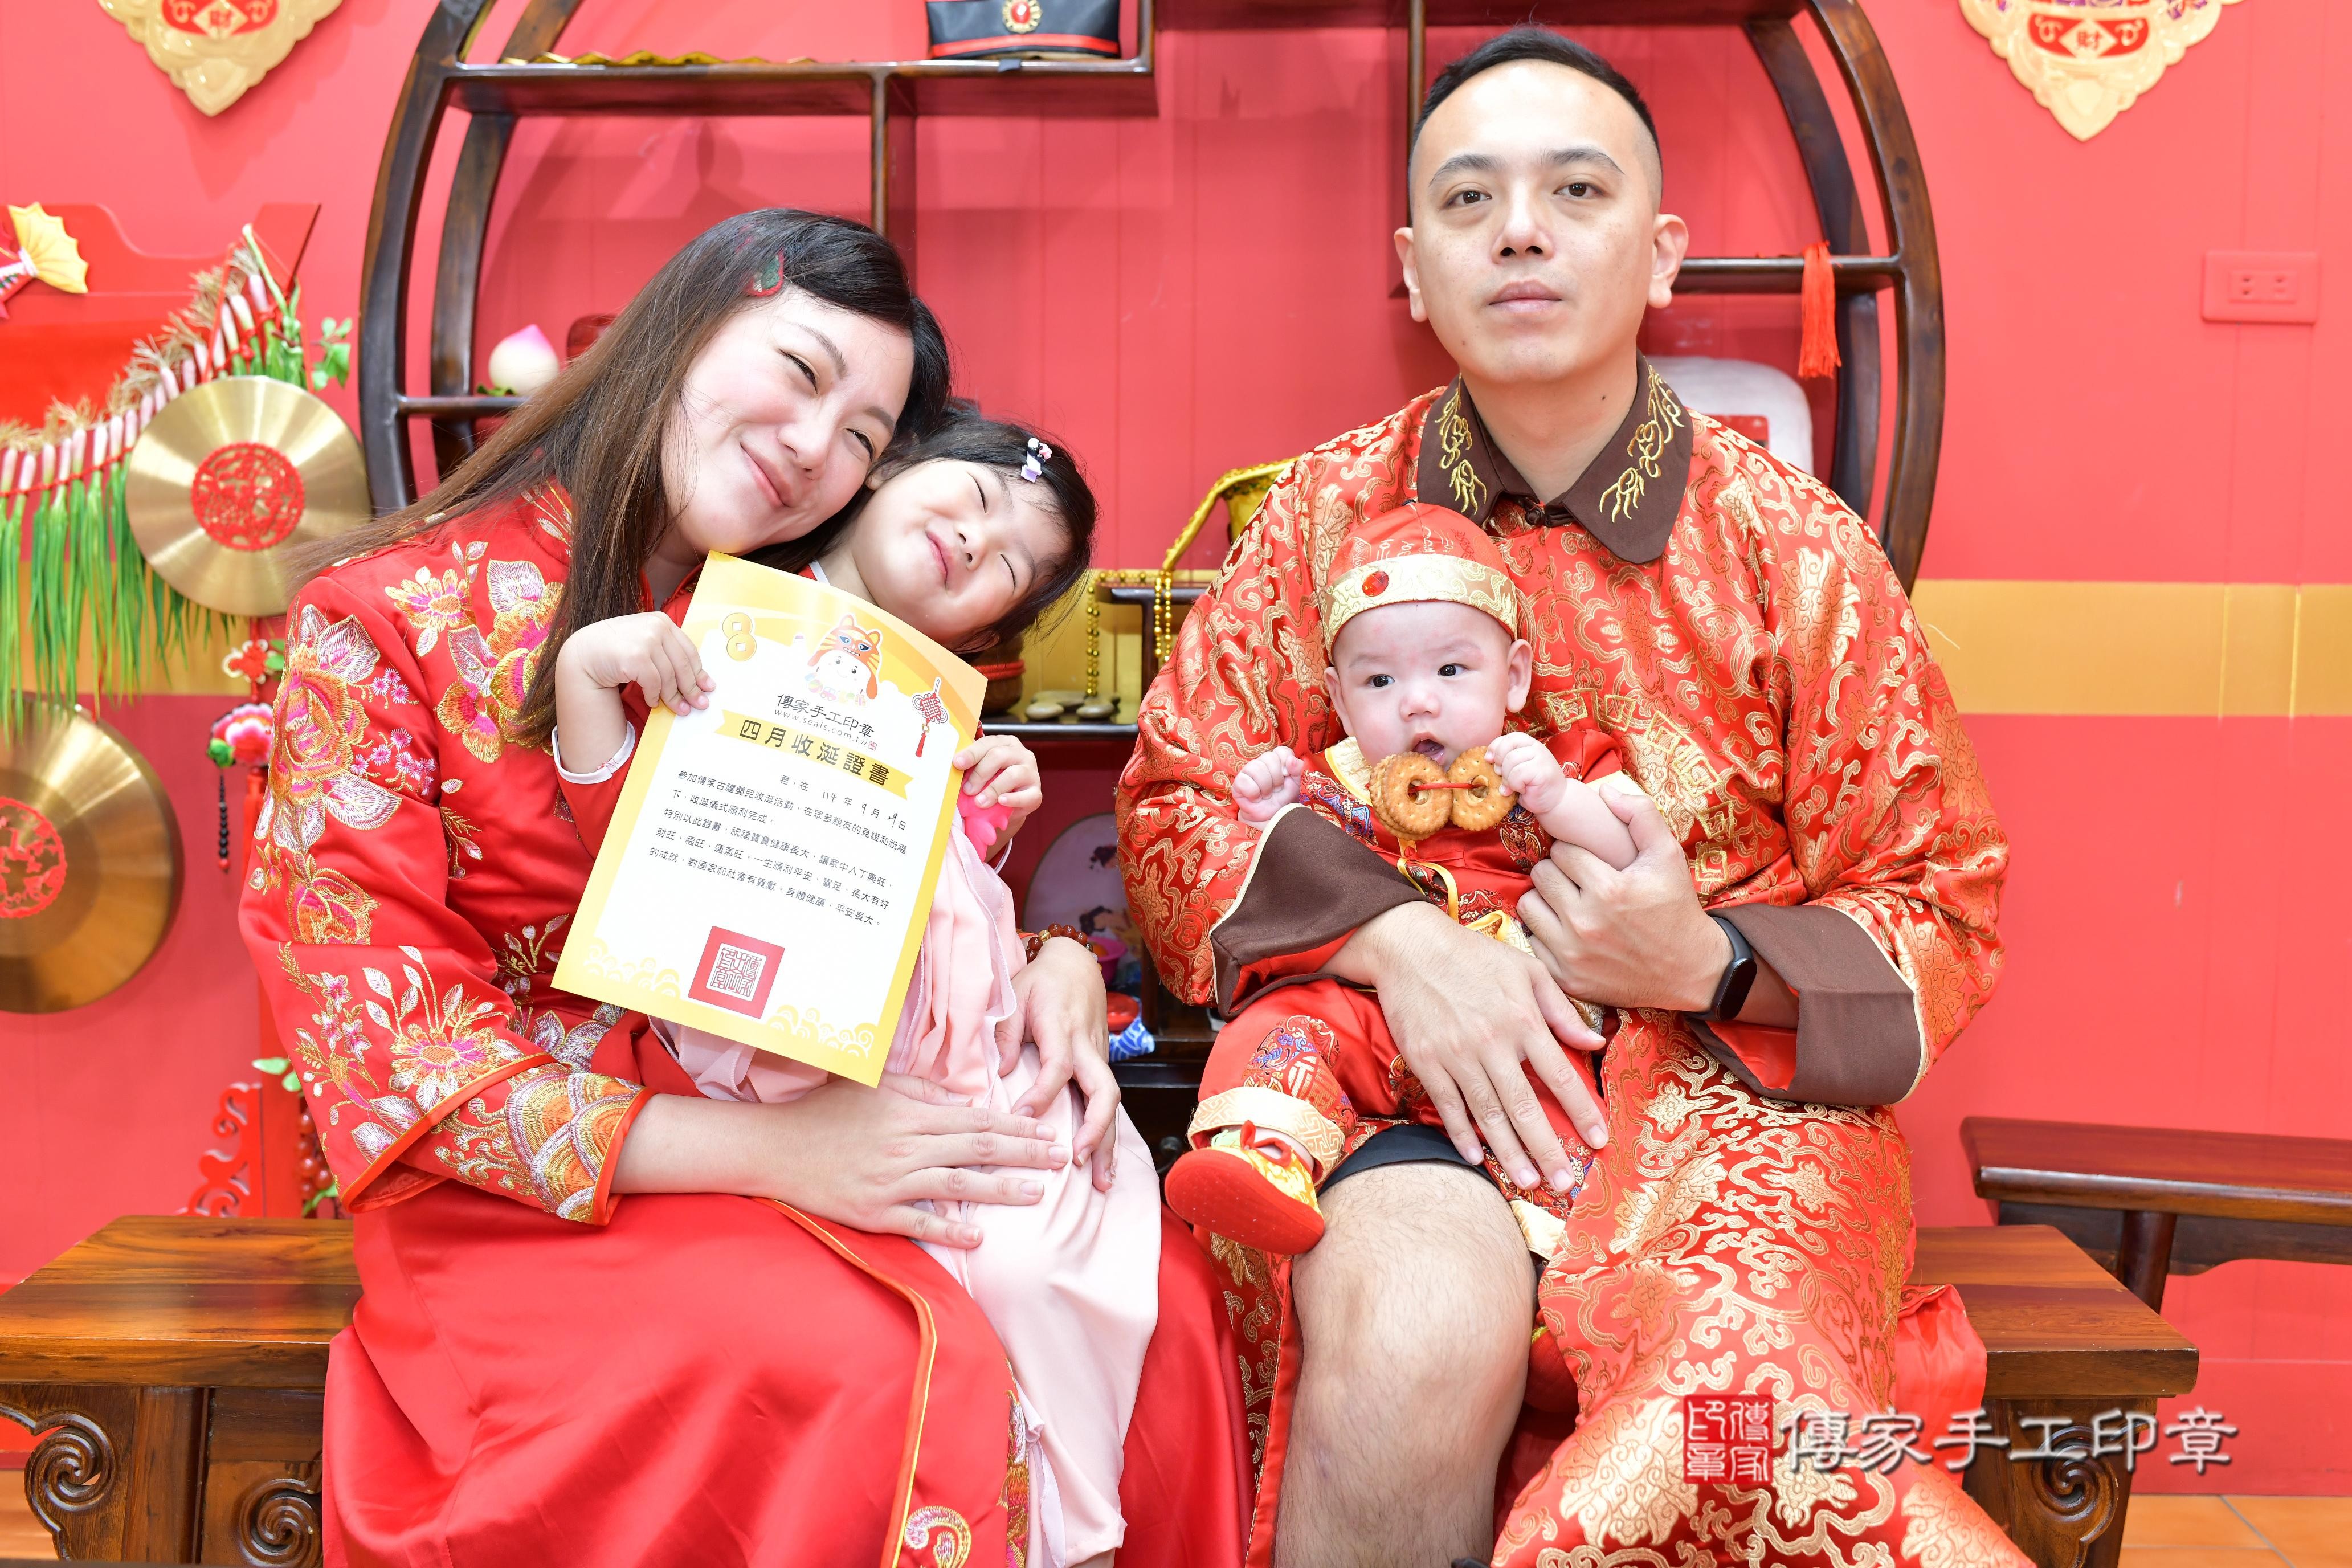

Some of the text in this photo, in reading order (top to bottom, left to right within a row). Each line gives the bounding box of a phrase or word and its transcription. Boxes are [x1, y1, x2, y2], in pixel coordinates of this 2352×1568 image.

[774, 709, 867, 746] www.seals.com.tw
[777, 693, 875, 738] 傳家手工印章
[740, 720, 890, 786] 四月收涎證書
[843, 797, 852, 806] 年
[871, 808, 880, 818] 月
[899, 820, 906, 830] 日
